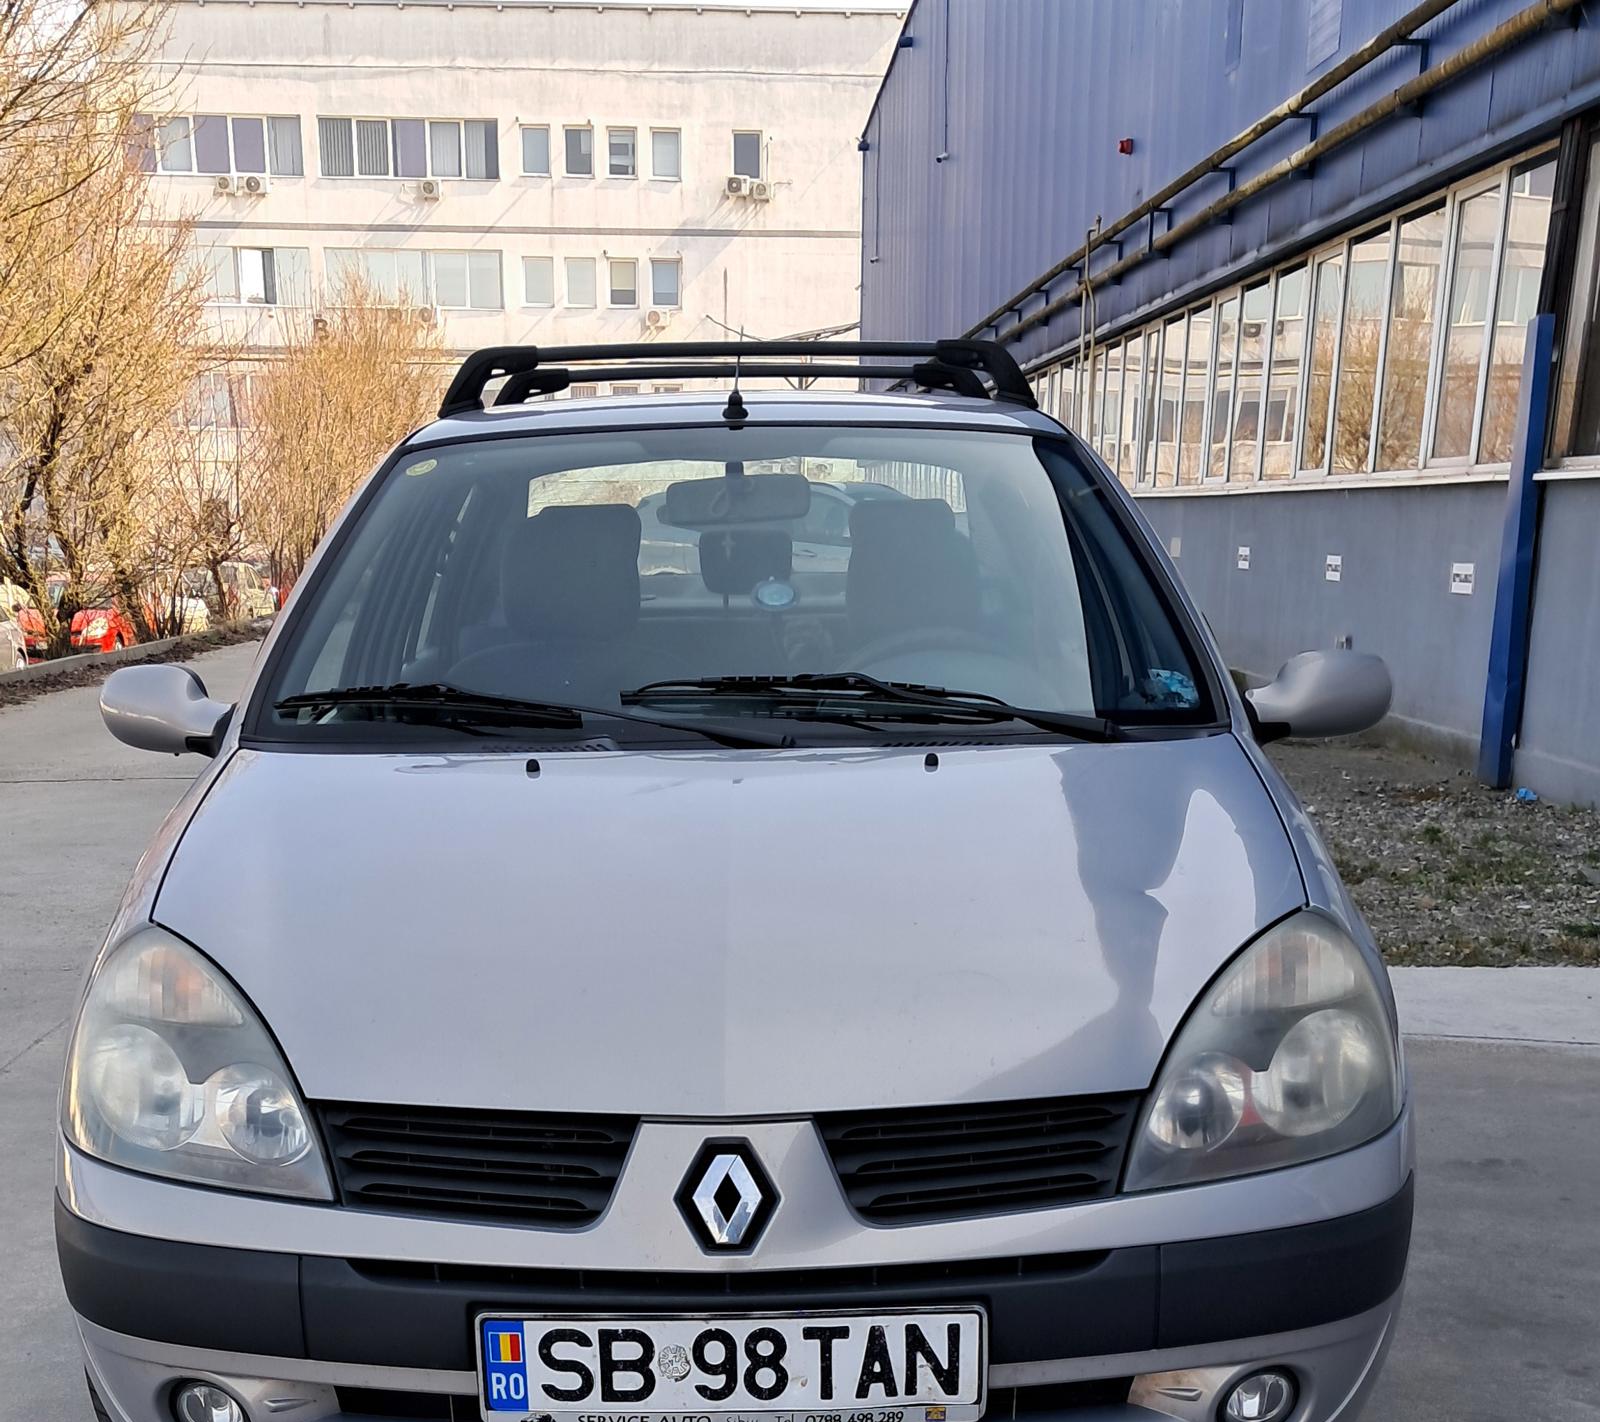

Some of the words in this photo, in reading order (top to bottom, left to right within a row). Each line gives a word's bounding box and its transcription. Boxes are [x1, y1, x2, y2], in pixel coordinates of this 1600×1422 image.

[492, 1371, 524, 1399] RO
[538, 1328, 656, 1402] SB
[692, 1327, 788, 1402] 98
[803, 1323, 961, 1399] TAN
